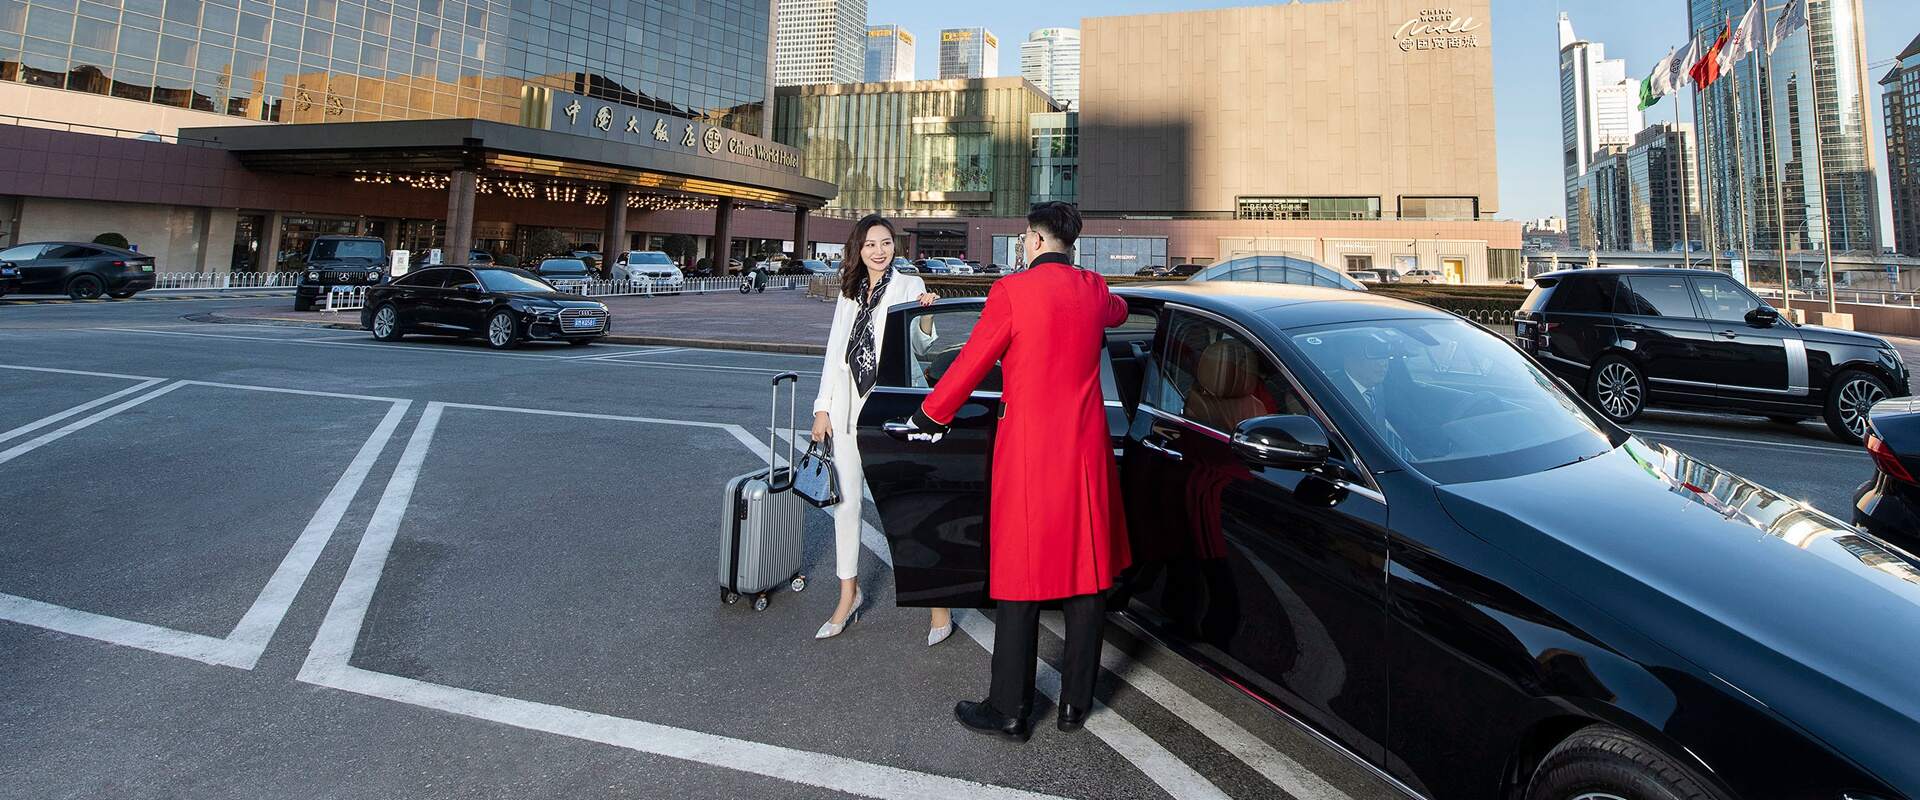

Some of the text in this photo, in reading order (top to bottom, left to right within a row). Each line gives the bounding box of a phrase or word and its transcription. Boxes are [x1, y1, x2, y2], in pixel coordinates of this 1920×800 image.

[1420, 14, 1451, 22] WORLD
[728, 137, 798, 168] China World Hotel
